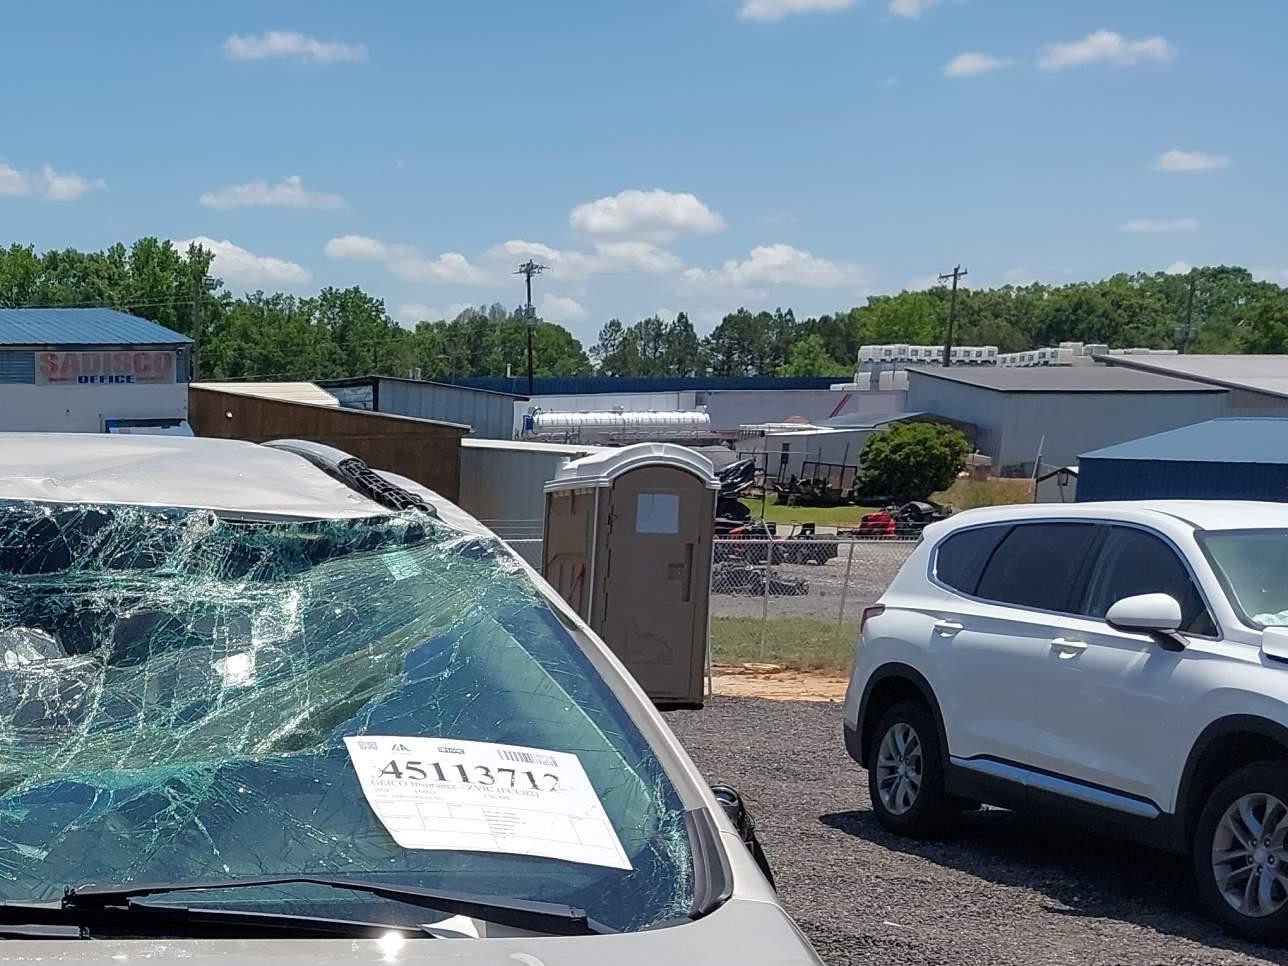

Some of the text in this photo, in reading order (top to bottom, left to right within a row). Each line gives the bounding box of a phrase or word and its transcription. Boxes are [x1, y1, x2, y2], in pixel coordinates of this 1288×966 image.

[39, 352, 173, 374] SADISCO
[77, 375, 137, 384] OFFICE
[378, 759, 564, 792] 45113712
